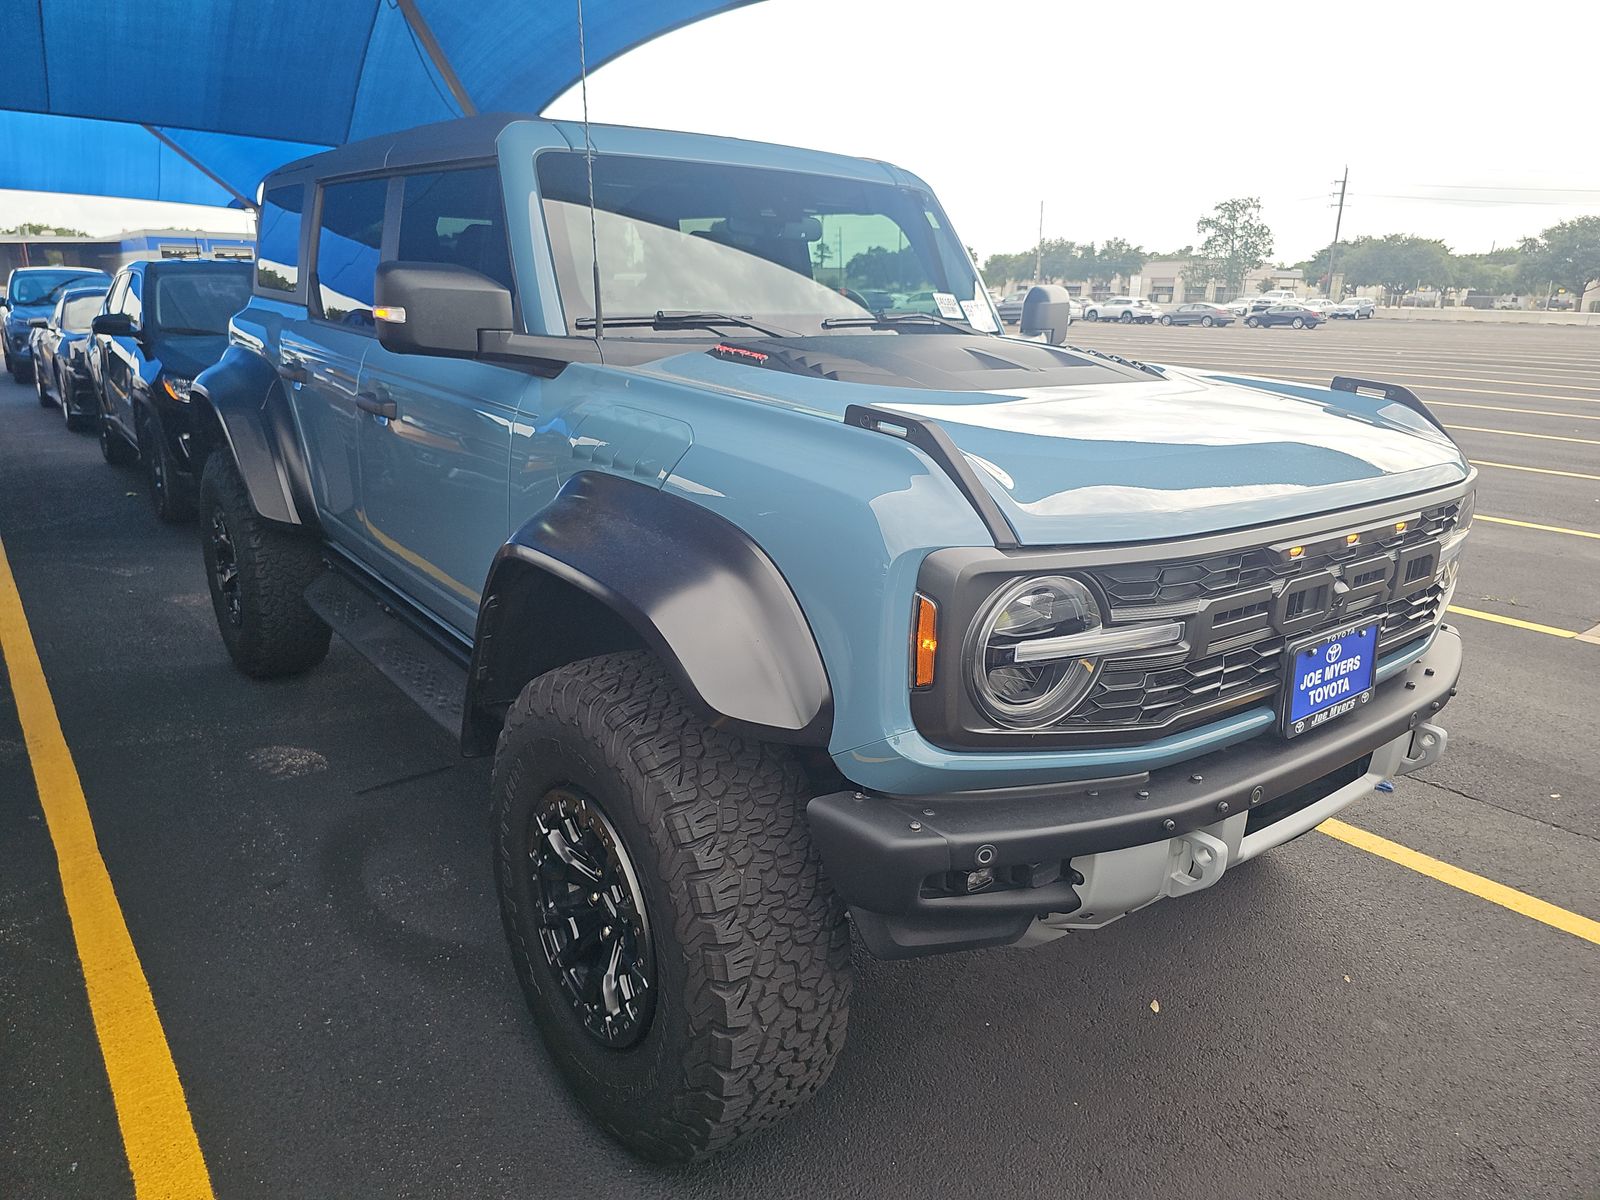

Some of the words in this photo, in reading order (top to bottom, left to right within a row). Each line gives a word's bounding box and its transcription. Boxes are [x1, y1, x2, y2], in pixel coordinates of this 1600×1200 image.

[1326, 628, 1355, 643] TOYOTA
[1300, 669, 1322, 691] JOE
[1324, 655, 1361, 681] MYERS
[1308, 677, 1350, 706] TOYOTA
[1311, 711, 1328, 726] Joe
[1329, 699, 1355, 716] Myers
